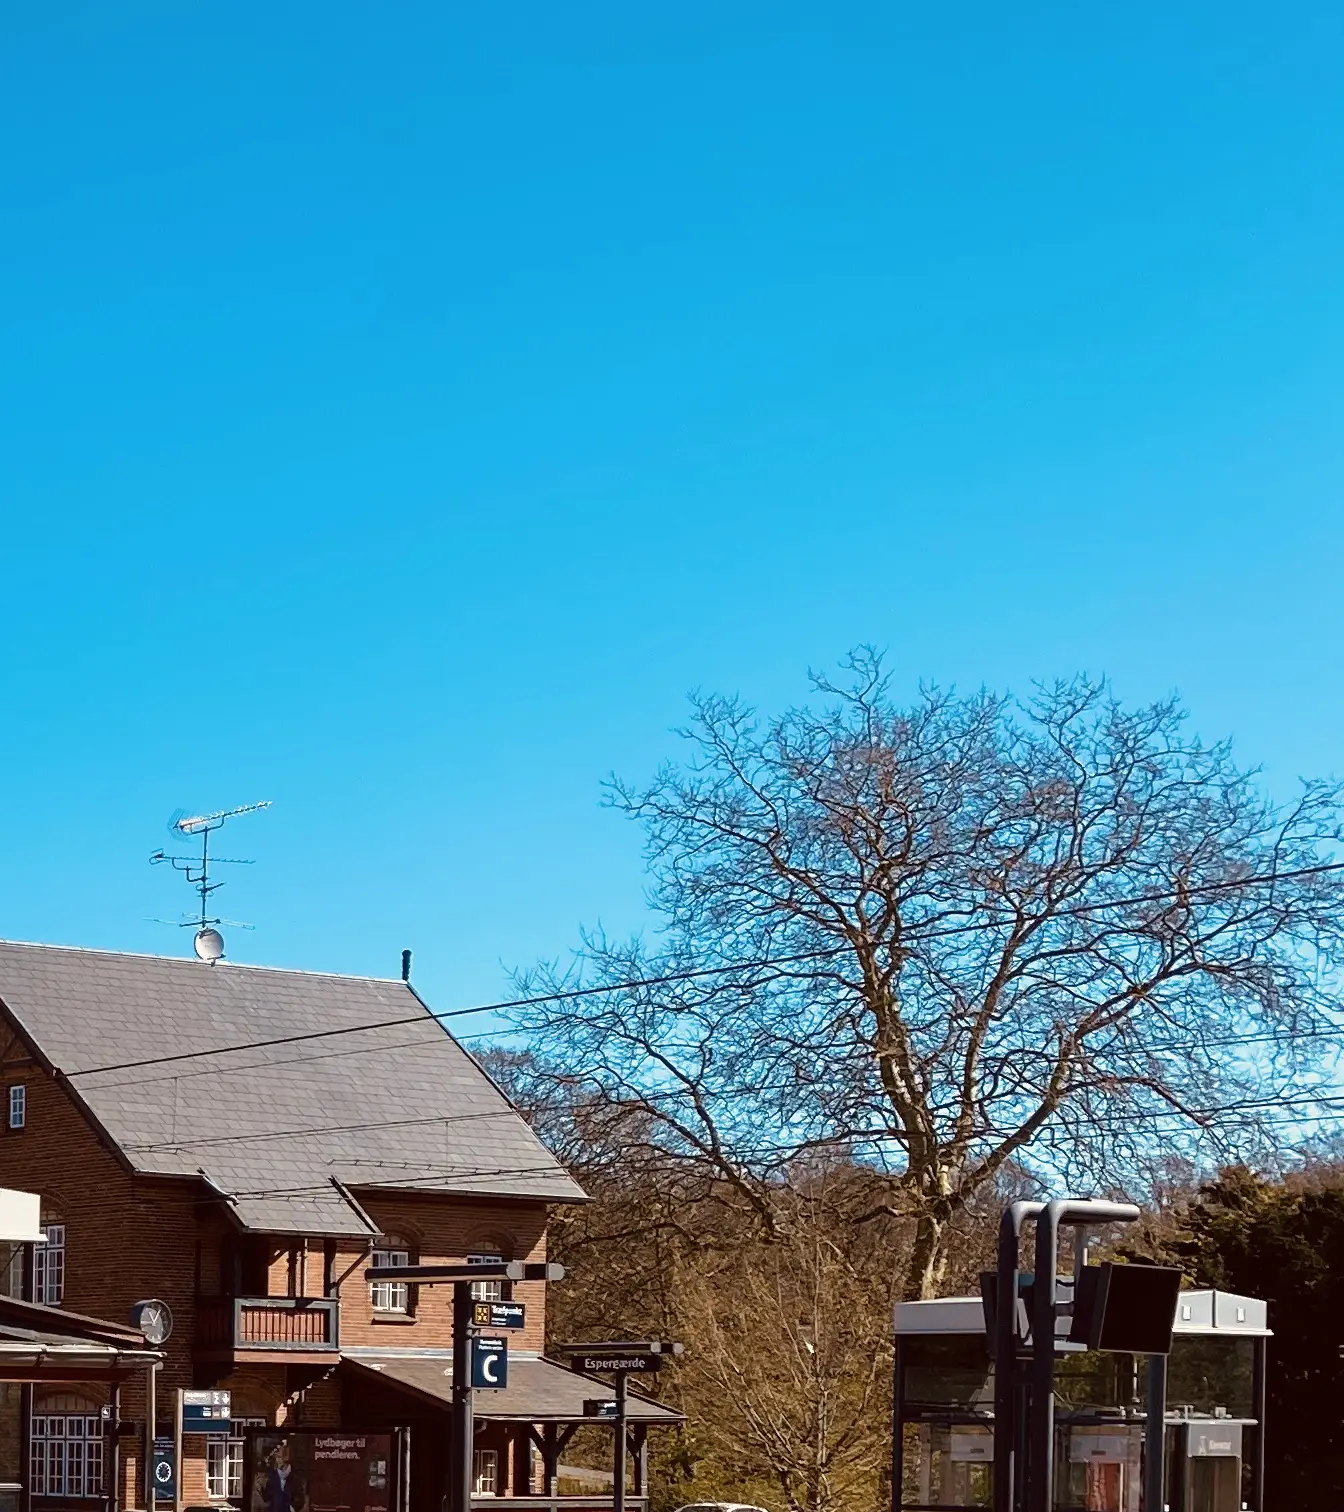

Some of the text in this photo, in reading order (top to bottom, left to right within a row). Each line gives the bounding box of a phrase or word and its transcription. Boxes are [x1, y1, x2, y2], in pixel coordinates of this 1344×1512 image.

[483, 1354, 498, 1383] C
[584, 1357, 646, 1370] Espergærde
[315, 1437, 366, 1450] Lydbøger til
